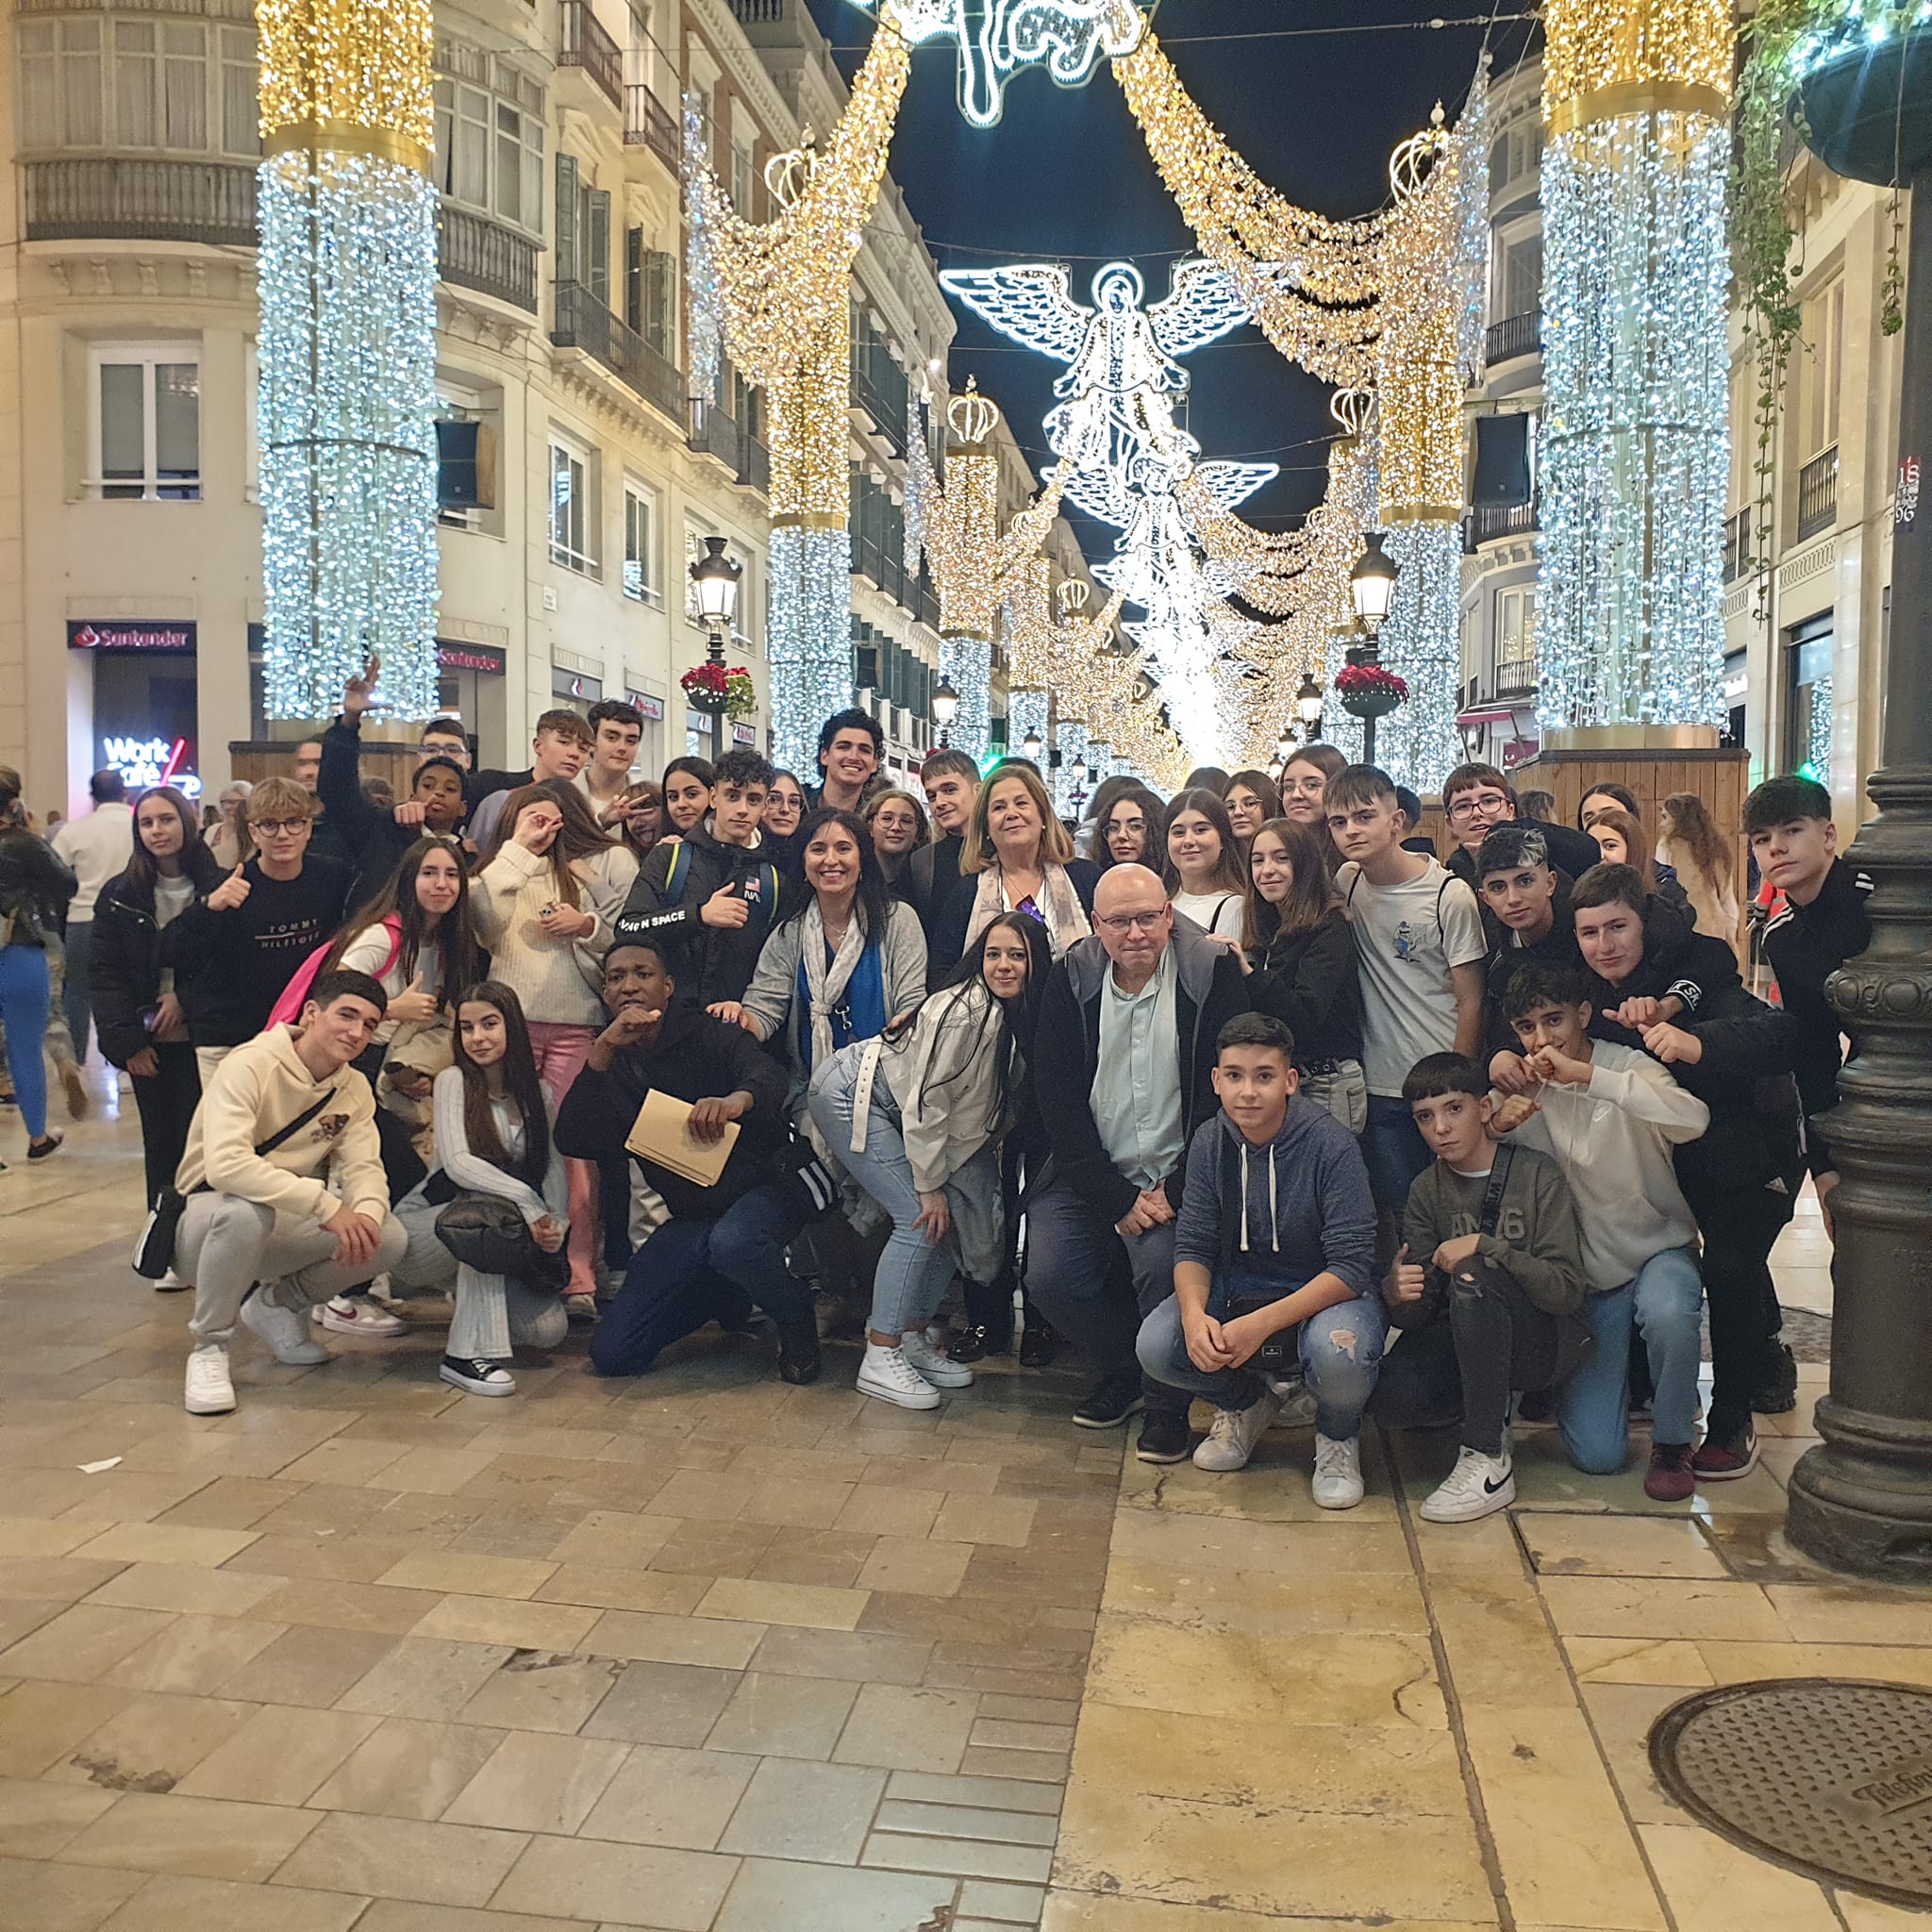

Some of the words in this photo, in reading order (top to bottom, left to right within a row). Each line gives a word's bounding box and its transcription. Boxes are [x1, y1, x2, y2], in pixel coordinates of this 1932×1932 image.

[98, 629, 188, 647] Santander
[103, 737, 171, 763] Work
[651, 910, 686, 926] SPACE
